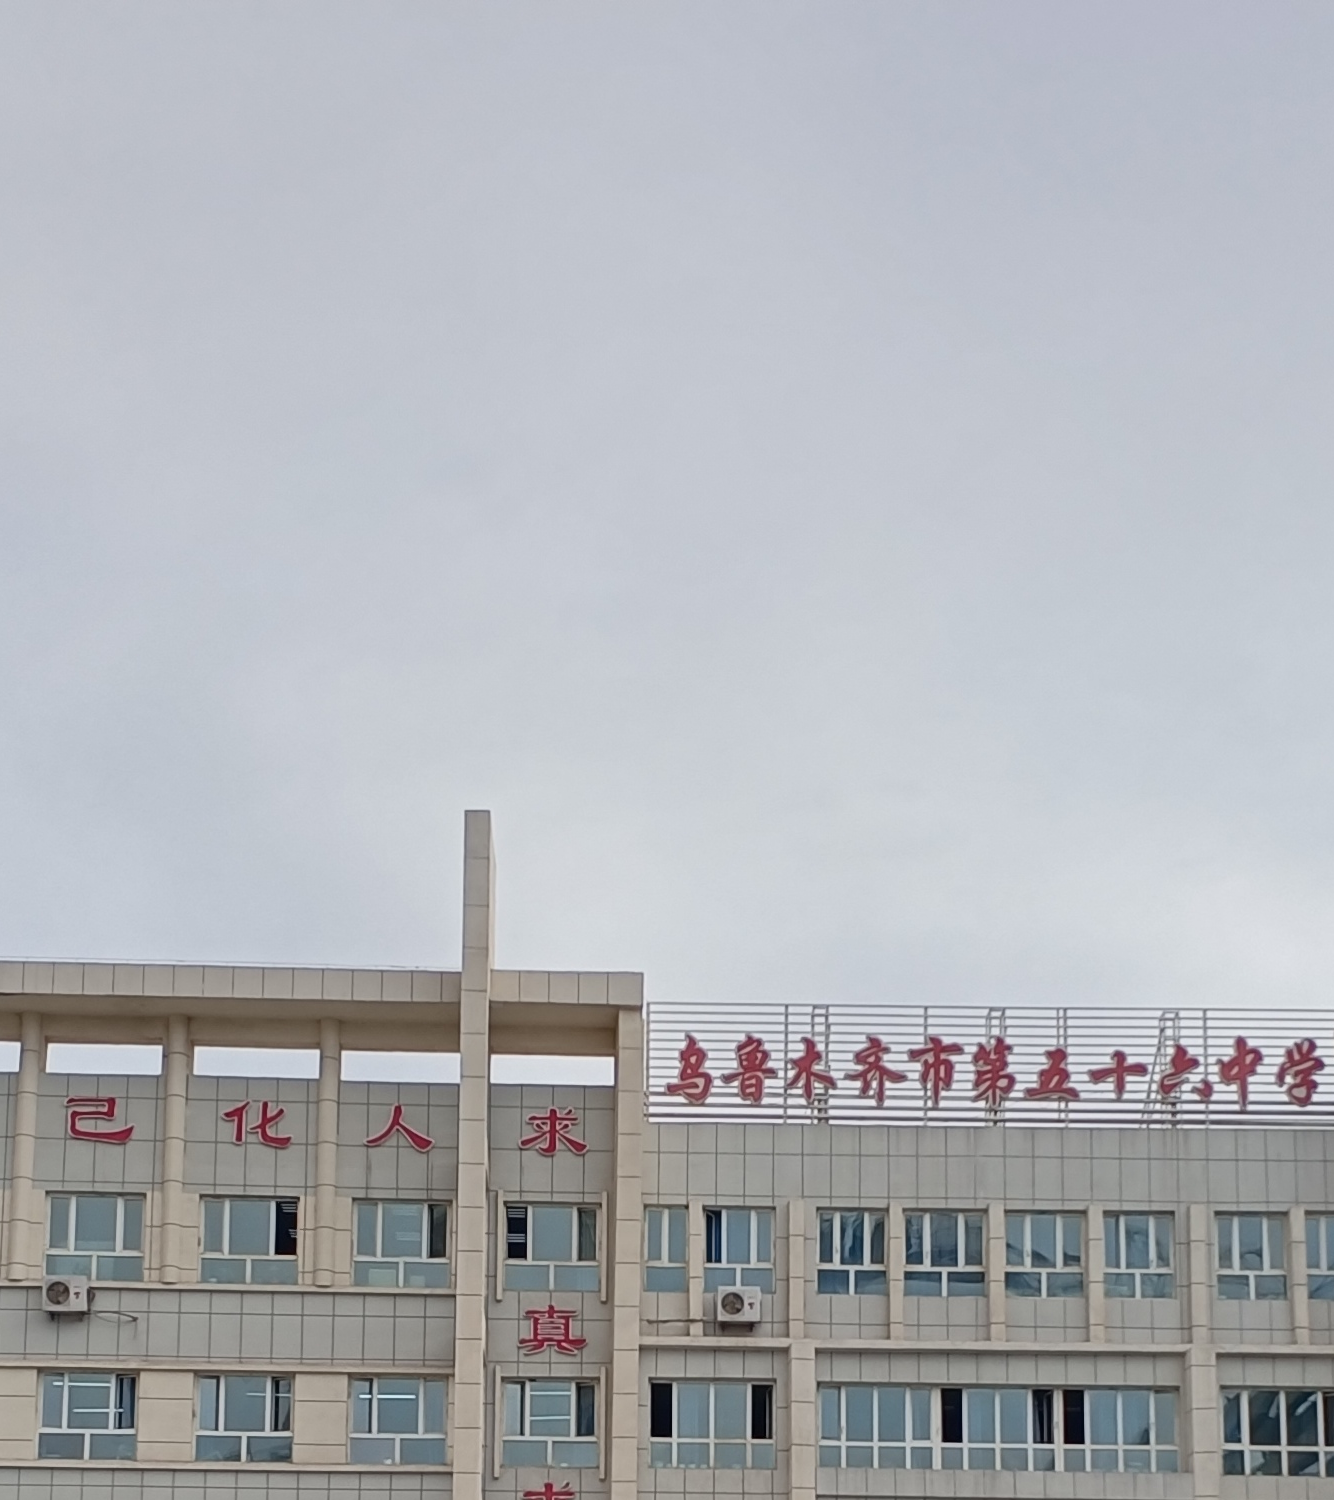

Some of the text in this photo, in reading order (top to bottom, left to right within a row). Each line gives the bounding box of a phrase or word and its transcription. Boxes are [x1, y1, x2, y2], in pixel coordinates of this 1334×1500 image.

[665, 1033, 1327, 1108] 乌鲁木齐市第五十六中学
